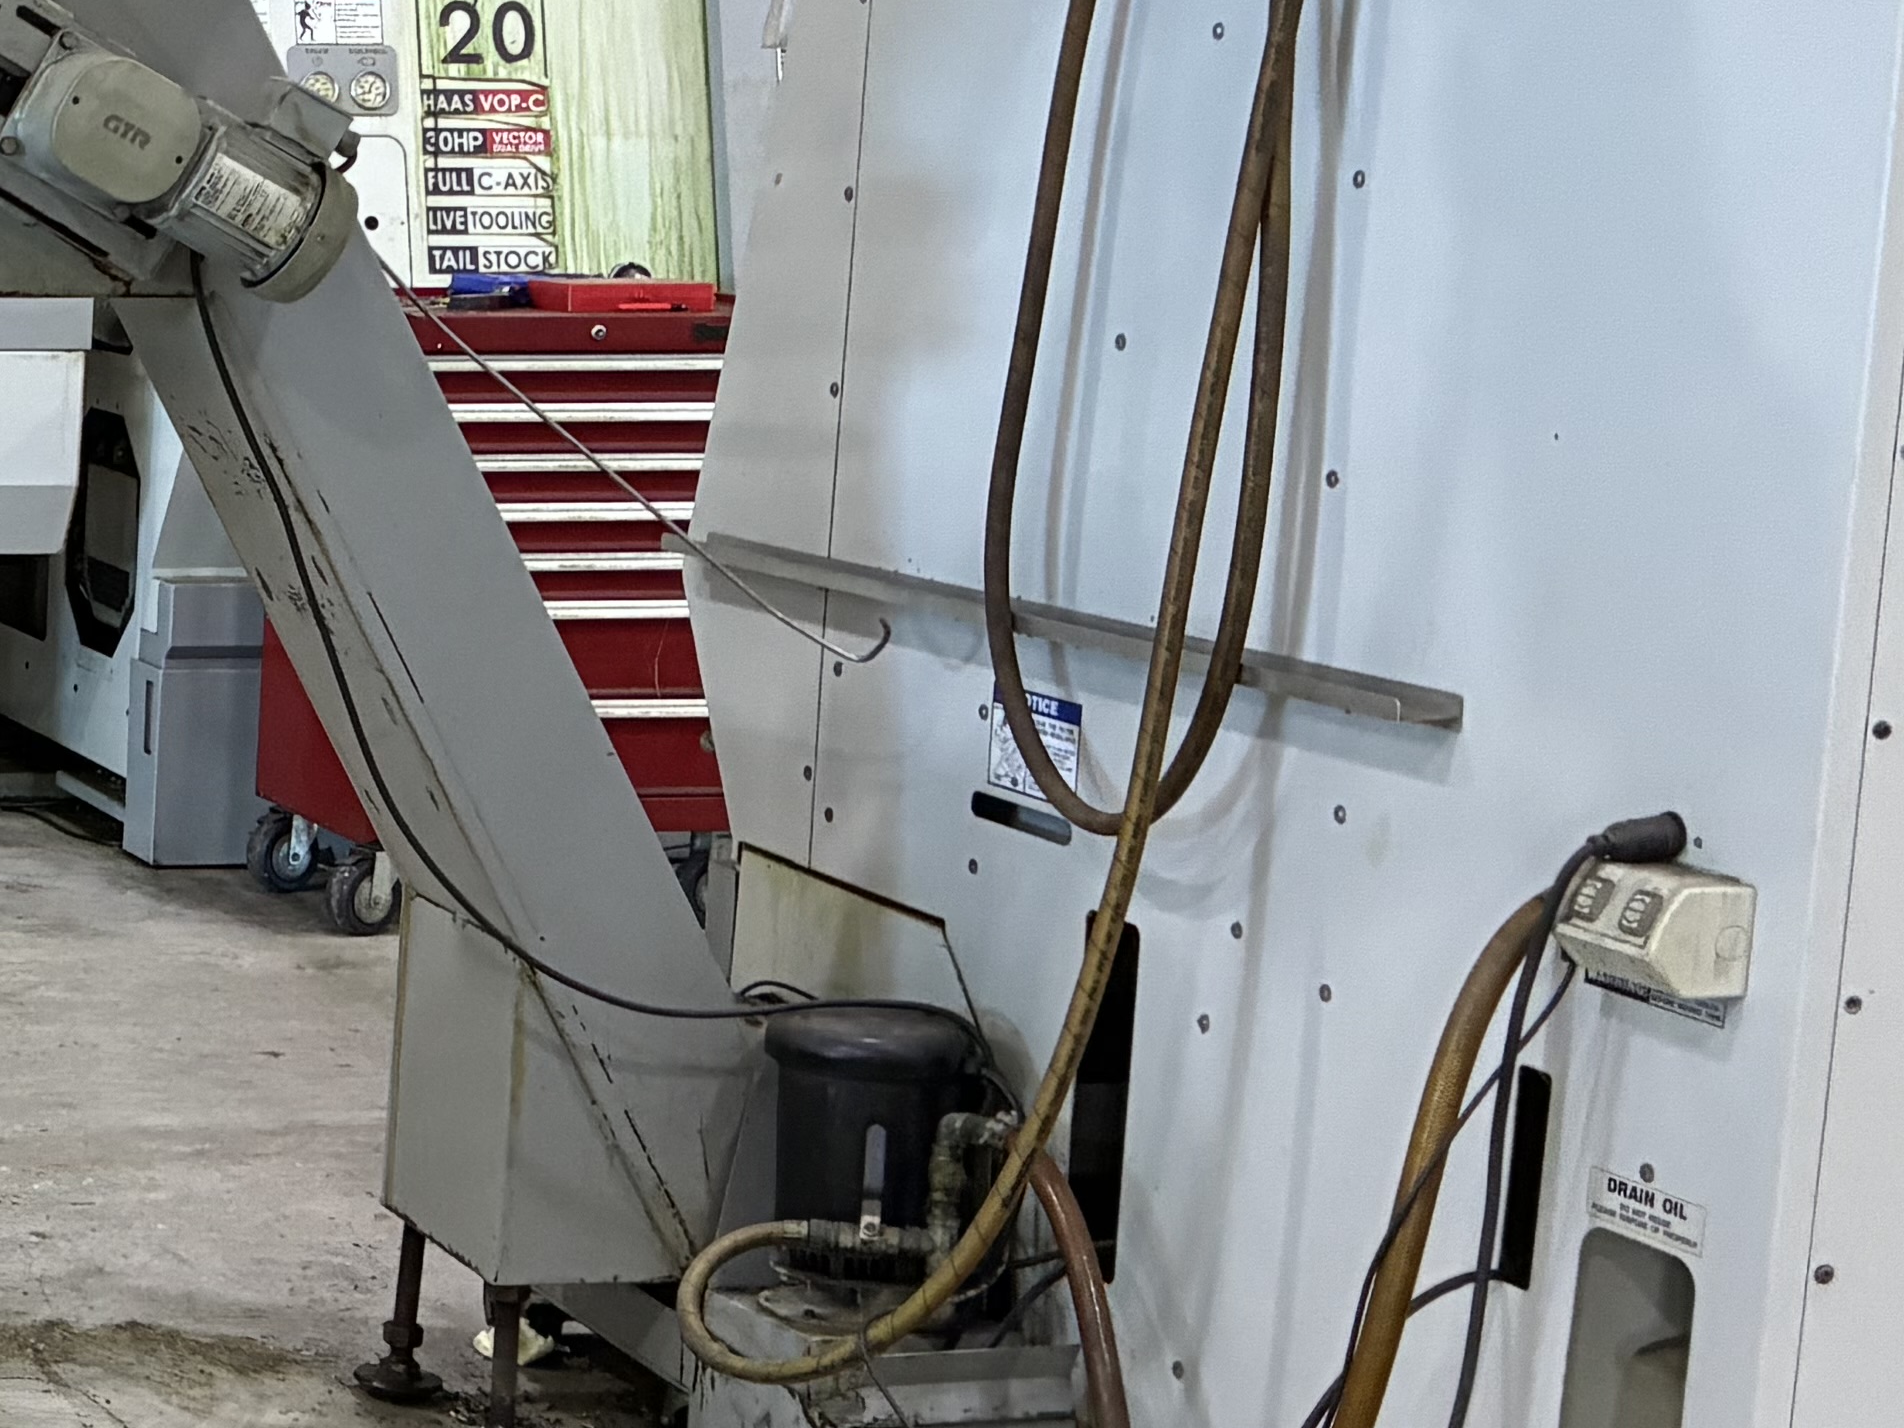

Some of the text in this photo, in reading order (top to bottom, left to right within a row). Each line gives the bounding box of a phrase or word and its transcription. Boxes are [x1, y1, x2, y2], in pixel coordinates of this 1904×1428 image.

[439, 0, 536, 65] 20
[423, 93, 545, 113] HAAS VOP-C
[425, 130, 544, 152] 30HP VECTOR
[427, 171, 552, 192] FULL C-AXIS
[428, 210, 554, 231] LIVE TOOLING
[431, 249, 554, 270] TAIL STOCK
[1607, 1177, 1688, 1222] DRAIN OIL
